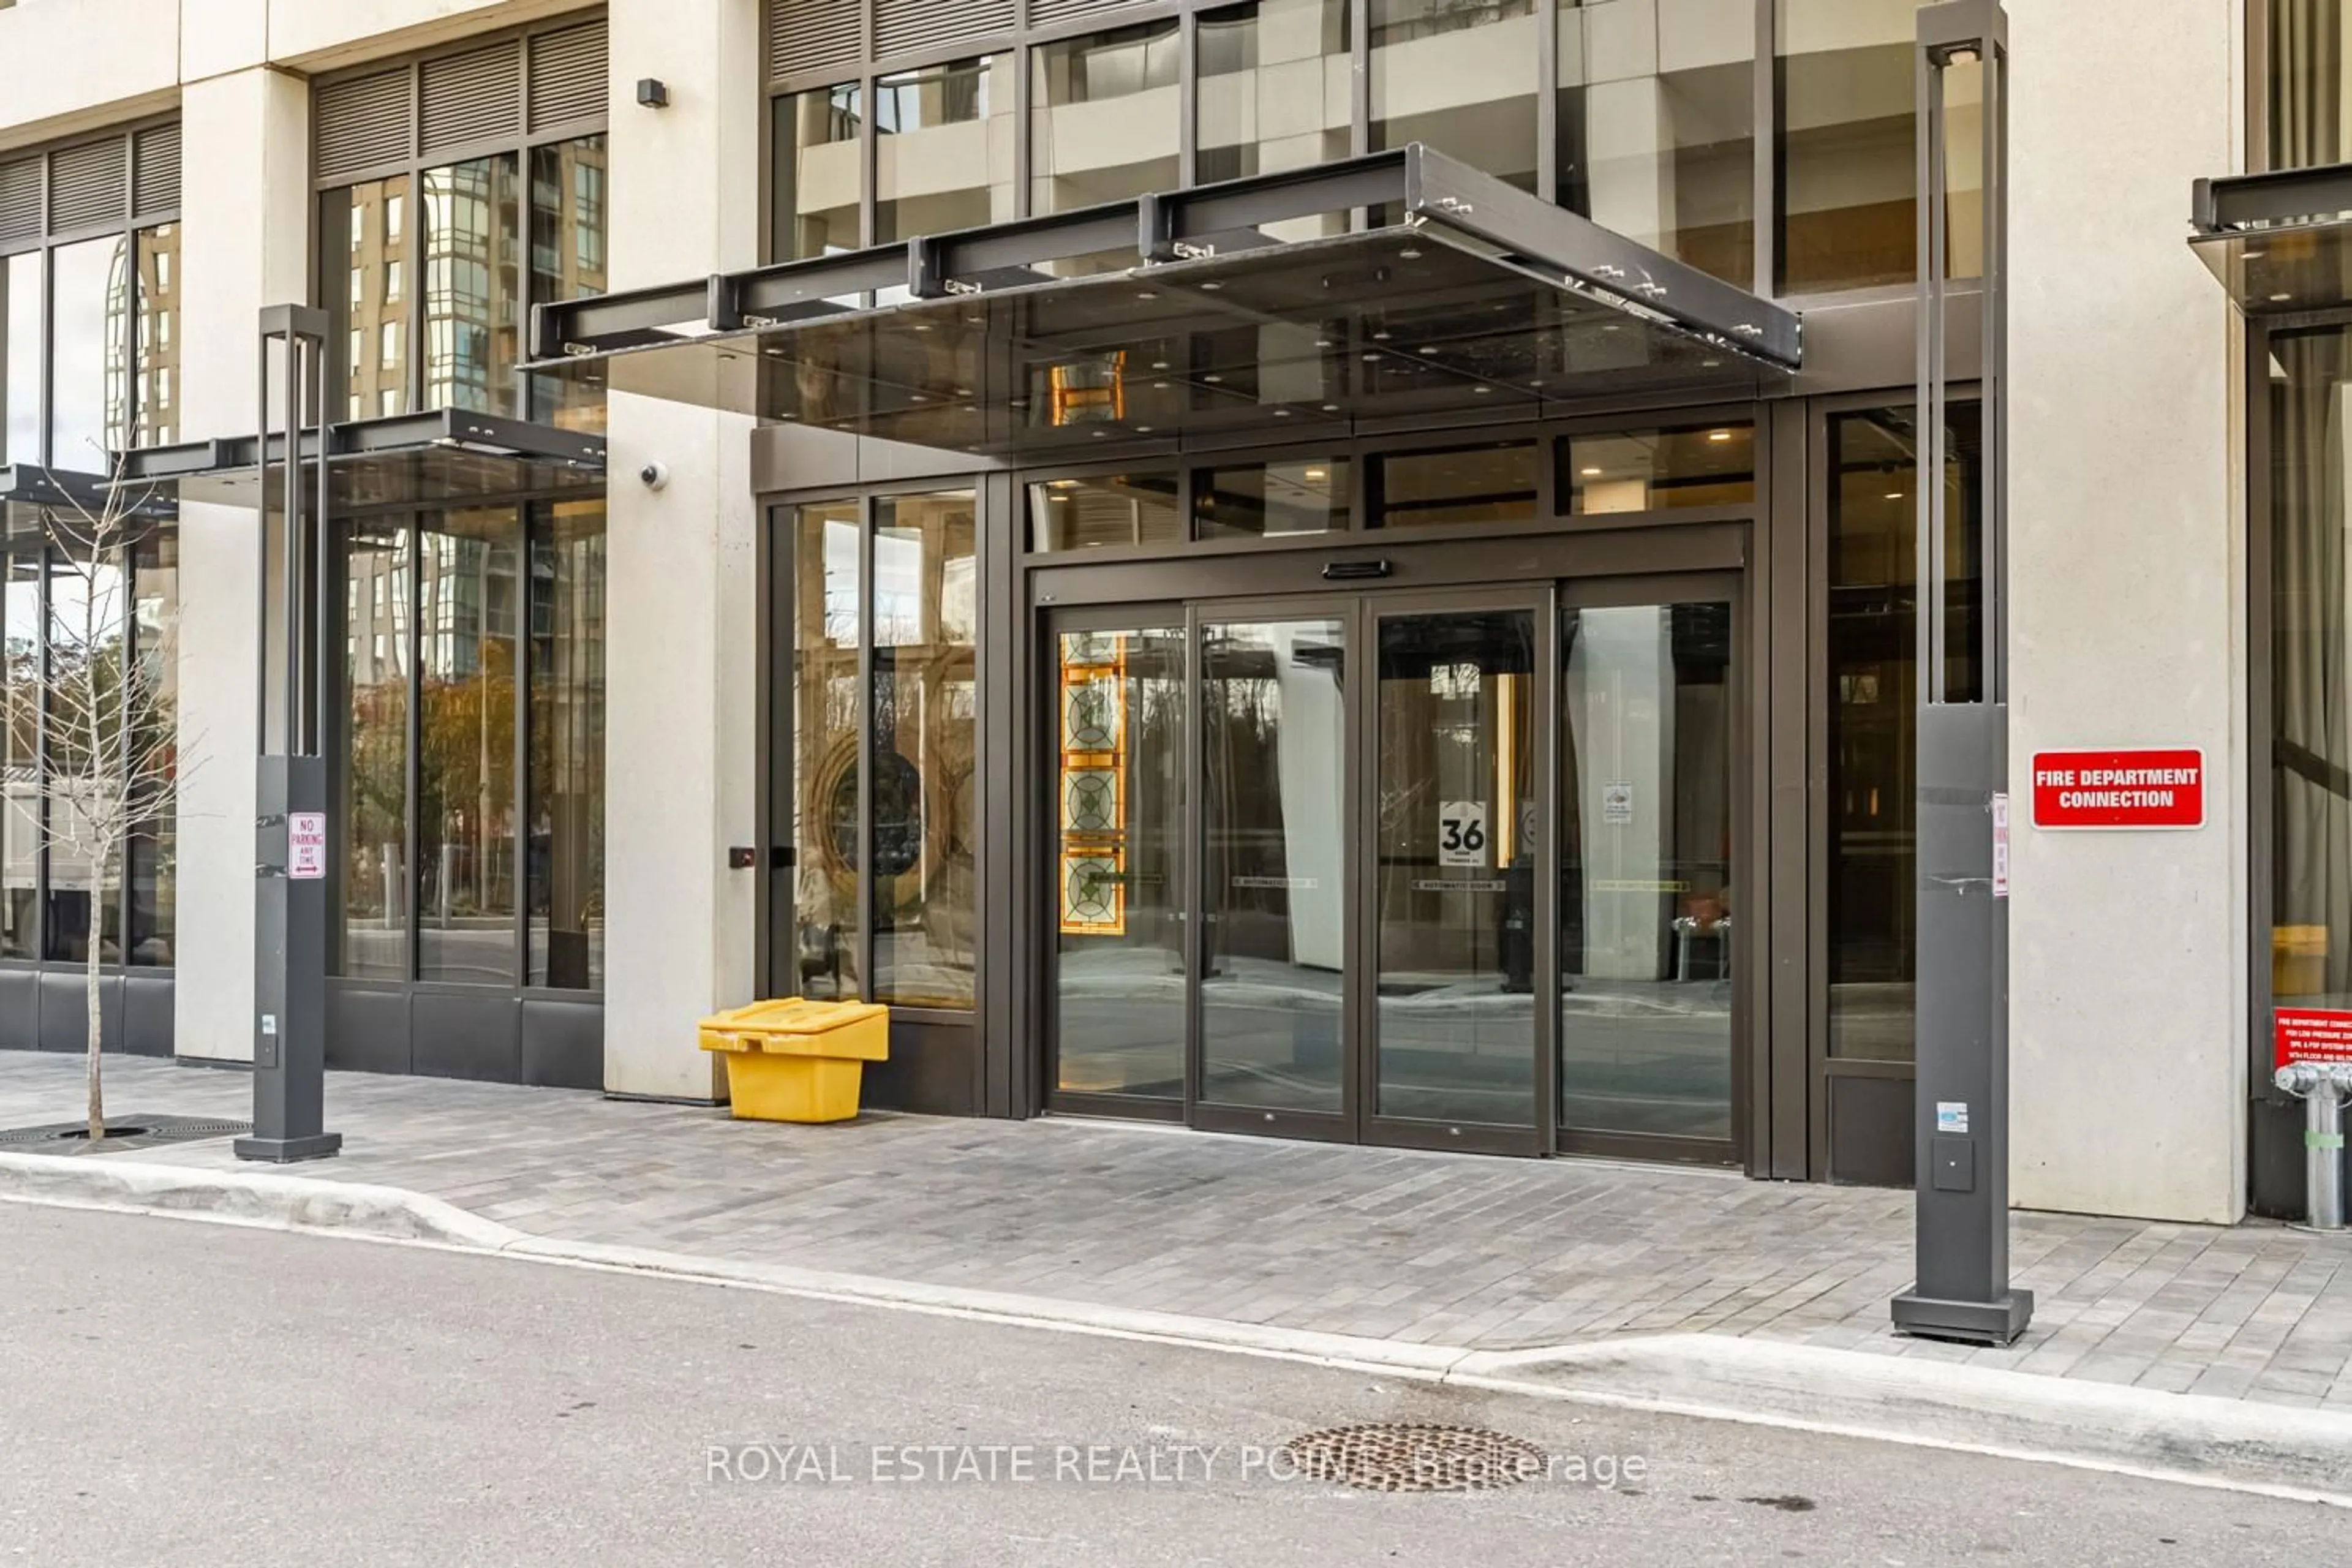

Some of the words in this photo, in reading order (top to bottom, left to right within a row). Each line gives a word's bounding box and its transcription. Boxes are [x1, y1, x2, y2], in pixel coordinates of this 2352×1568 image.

[2037, 771, 2075, 786] FIRE
[2081, 769, 2198, 786] DEPARTMENT
[2059, 790, 2173, 808] CONNECTION
[300, 820, 314, 831] NO
[292, 834, 322, 845] PARKING
[1442, 820, 1484, 851] 36
